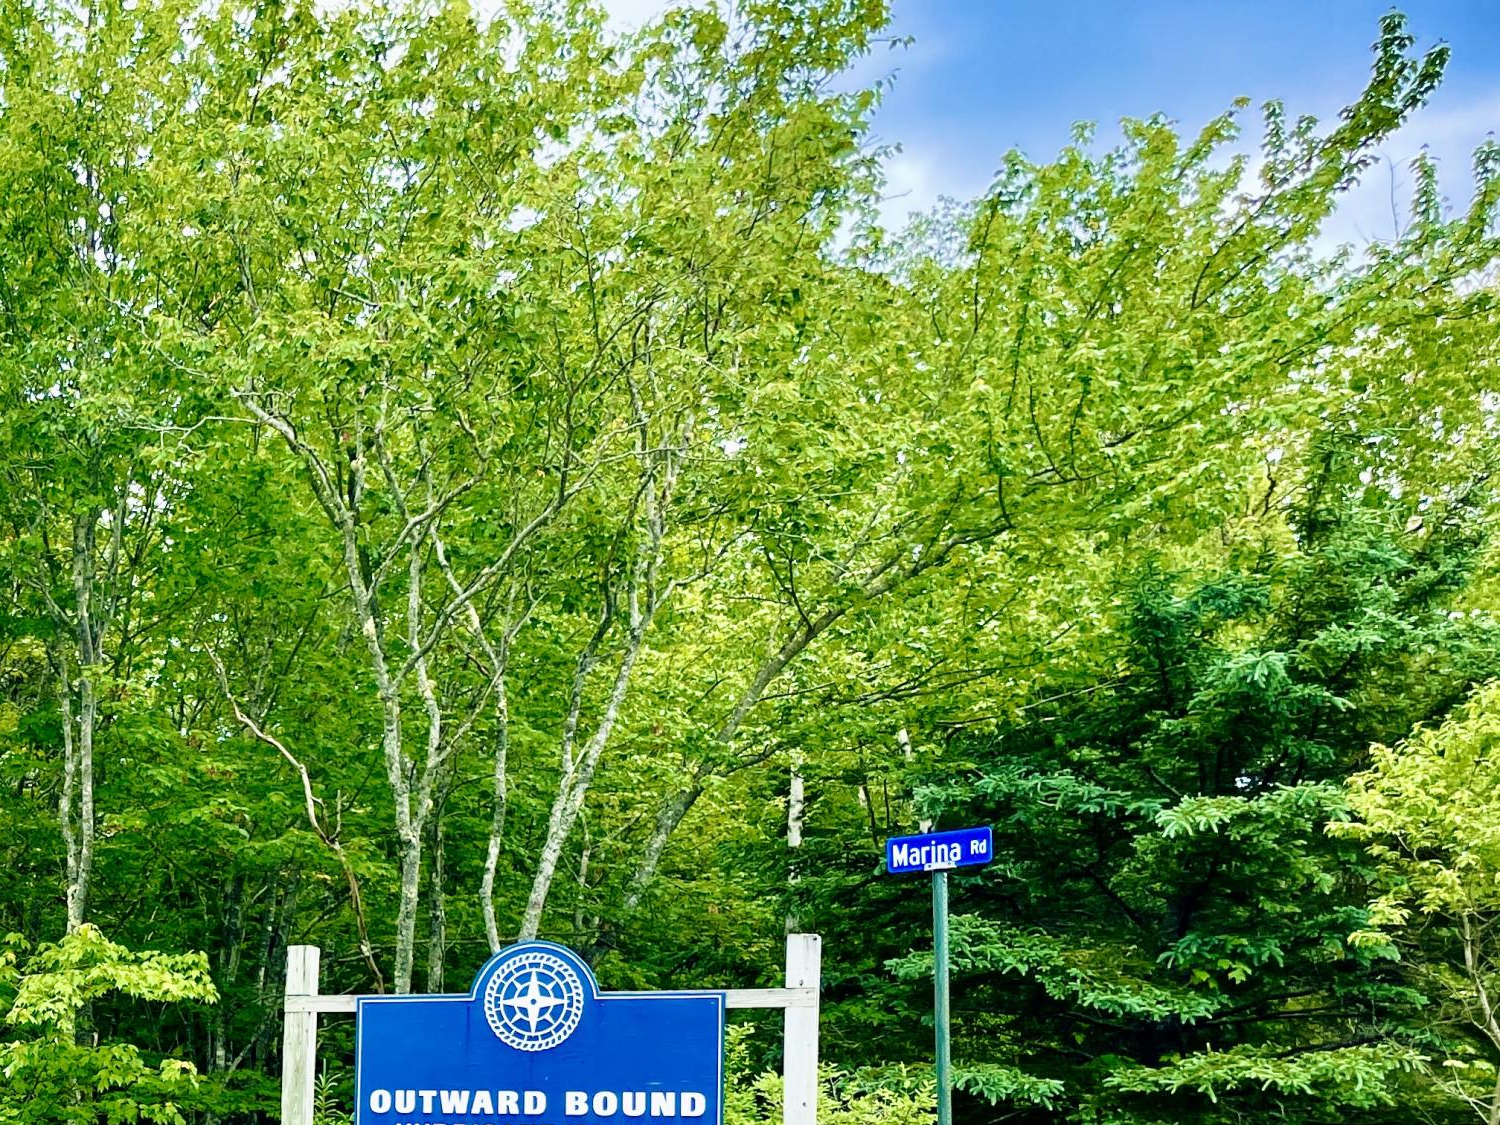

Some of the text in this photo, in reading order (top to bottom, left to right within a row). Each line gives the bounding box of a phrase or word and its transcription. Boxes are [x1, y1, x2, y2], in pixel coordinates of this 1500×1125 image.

[892, 839, 987, 868] Marina Rd
[369, 1089, 707, 1117] OUTWARD BOUND
